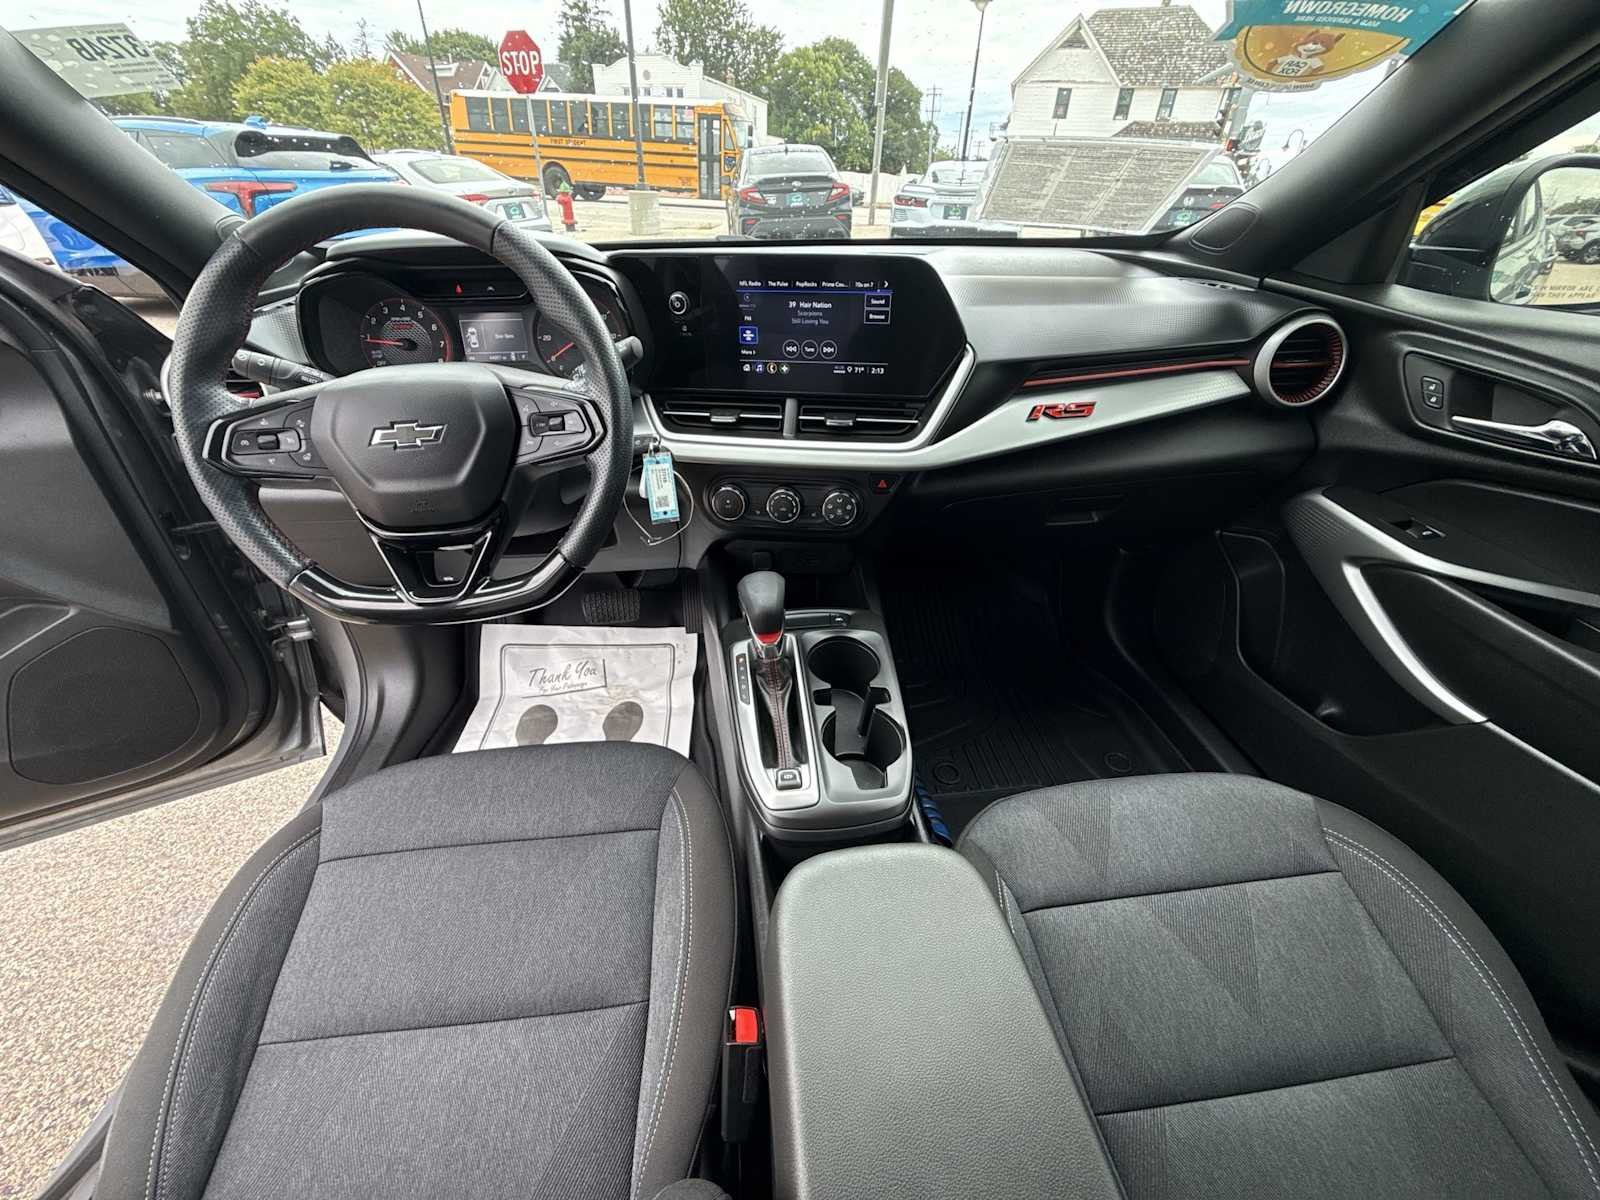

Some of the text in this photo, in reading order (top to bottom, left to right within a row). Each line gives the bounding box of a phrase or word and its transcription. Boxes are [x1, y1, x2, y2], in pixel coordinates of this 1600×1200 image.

[502, 50, 540, 75] STOP
[400, 304, 406, 312] 4
[788, 301, 797, 309] 39
[812, 301, 832, 309] Nation
[417, 311, 424, 319] 5
[801, 318, 819, 326] Loving
[431, 323, 438, 332] 6
[439, 340, 445, 348] 7
[1025, 401, 1097, 422] RS
[529, 660, 598, 687] Thank You
